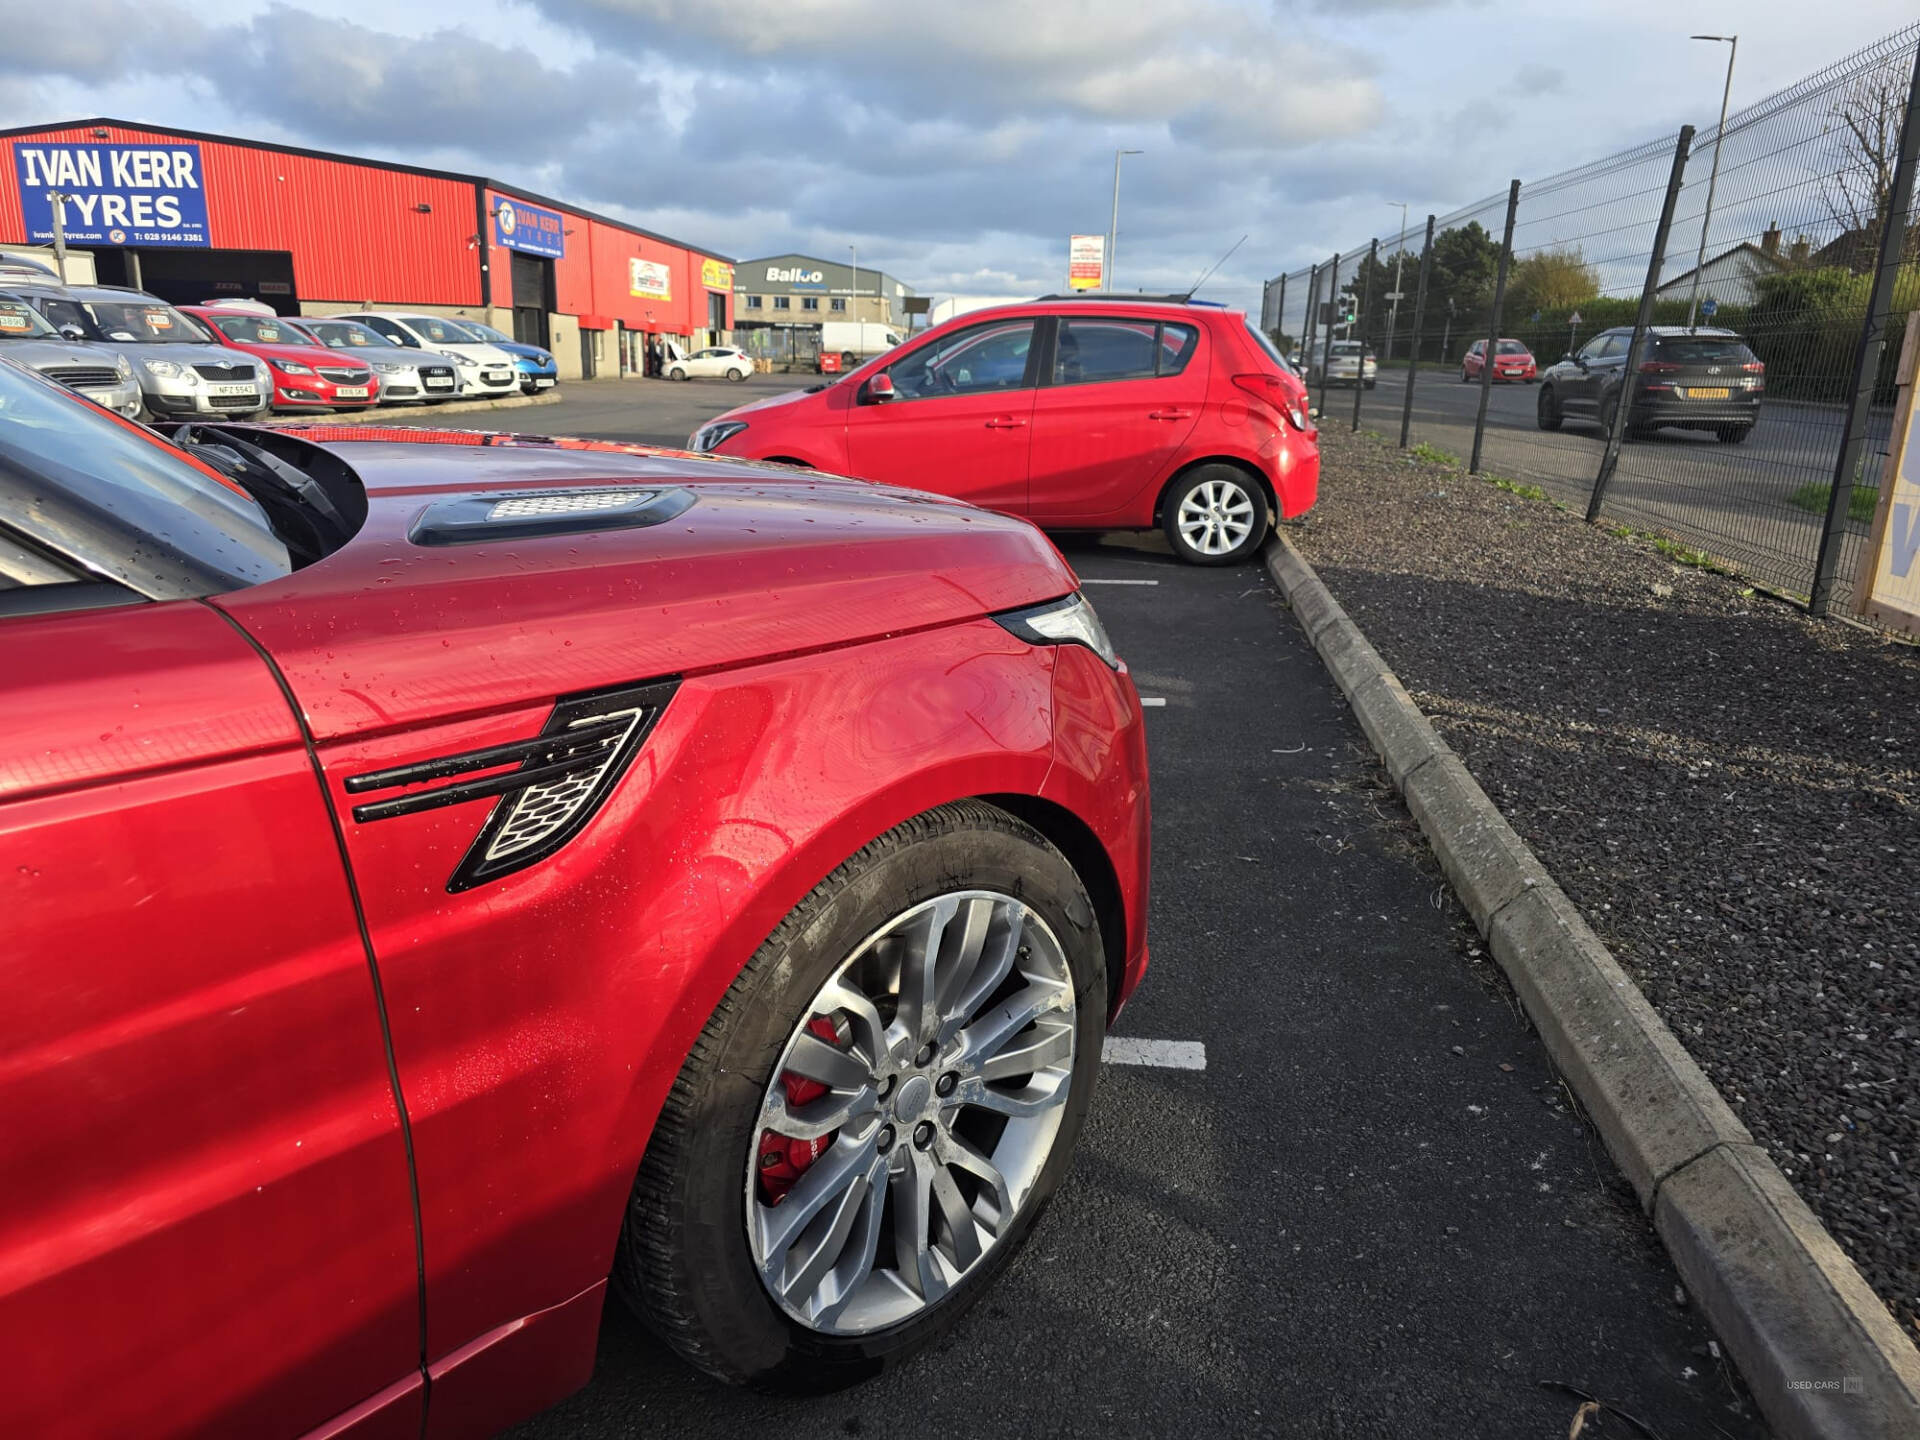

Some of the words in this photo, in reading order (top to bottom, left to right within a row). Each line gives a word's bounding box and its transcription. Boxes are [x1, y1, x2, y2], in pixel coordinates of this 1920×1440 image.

[21, 149, 103, 187] IVAN
[109, 150, 199, 189] KERR
[46, 194, 182, 228] TYRES
